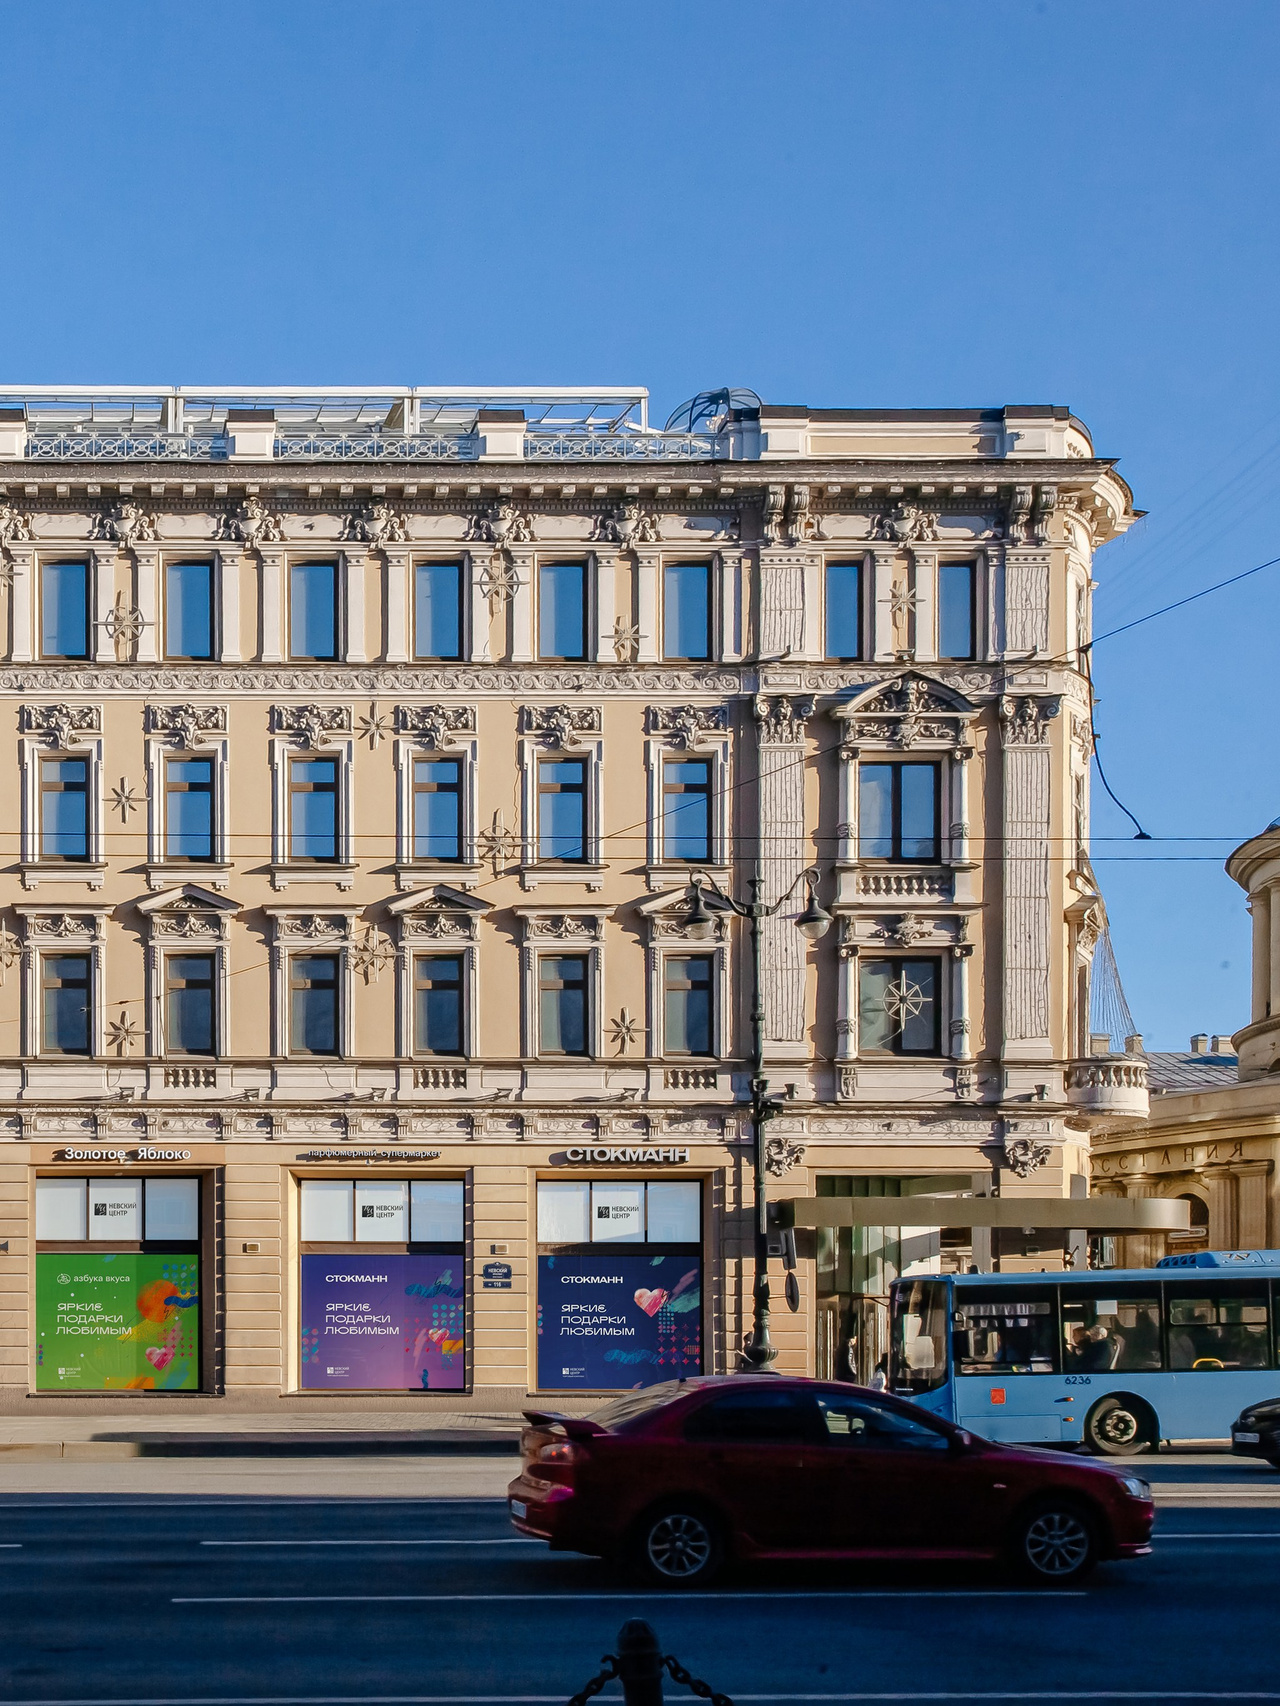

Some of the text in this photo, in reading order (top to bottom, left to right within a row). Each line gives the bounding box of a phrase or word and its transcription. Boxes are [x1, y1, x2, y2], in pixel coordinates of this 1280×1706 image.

[64, 1147, 192, 1160] Золотое Яблоко
[308, 1148, 442, 1159] парфюмерный супермаркет
[566, 1147, 690, 1162] СТОКМАНН
[73, 1274, 130, 1284] азбука вкуса
[325, 1274, 388, 1283] СТОКМАНН
[561, 1276, 624, 1284] СТОКМАНН
[57, 1315, 123, 1324] ПОДАРКИ
[325, 1315, 391, 1324] ПОДАРКИ
[561, 1316, 627, 1325] ПОДАРКИ
[56, 1327, 132, 1335] ЛЮБИМЫМ
[324, 1327, 400, 1335] ЛЮБИМЫМ
[560, 1328, 636, 1336] ЛЮБИМЫМ
[1064, 1376, 1092, 1385] 6236
